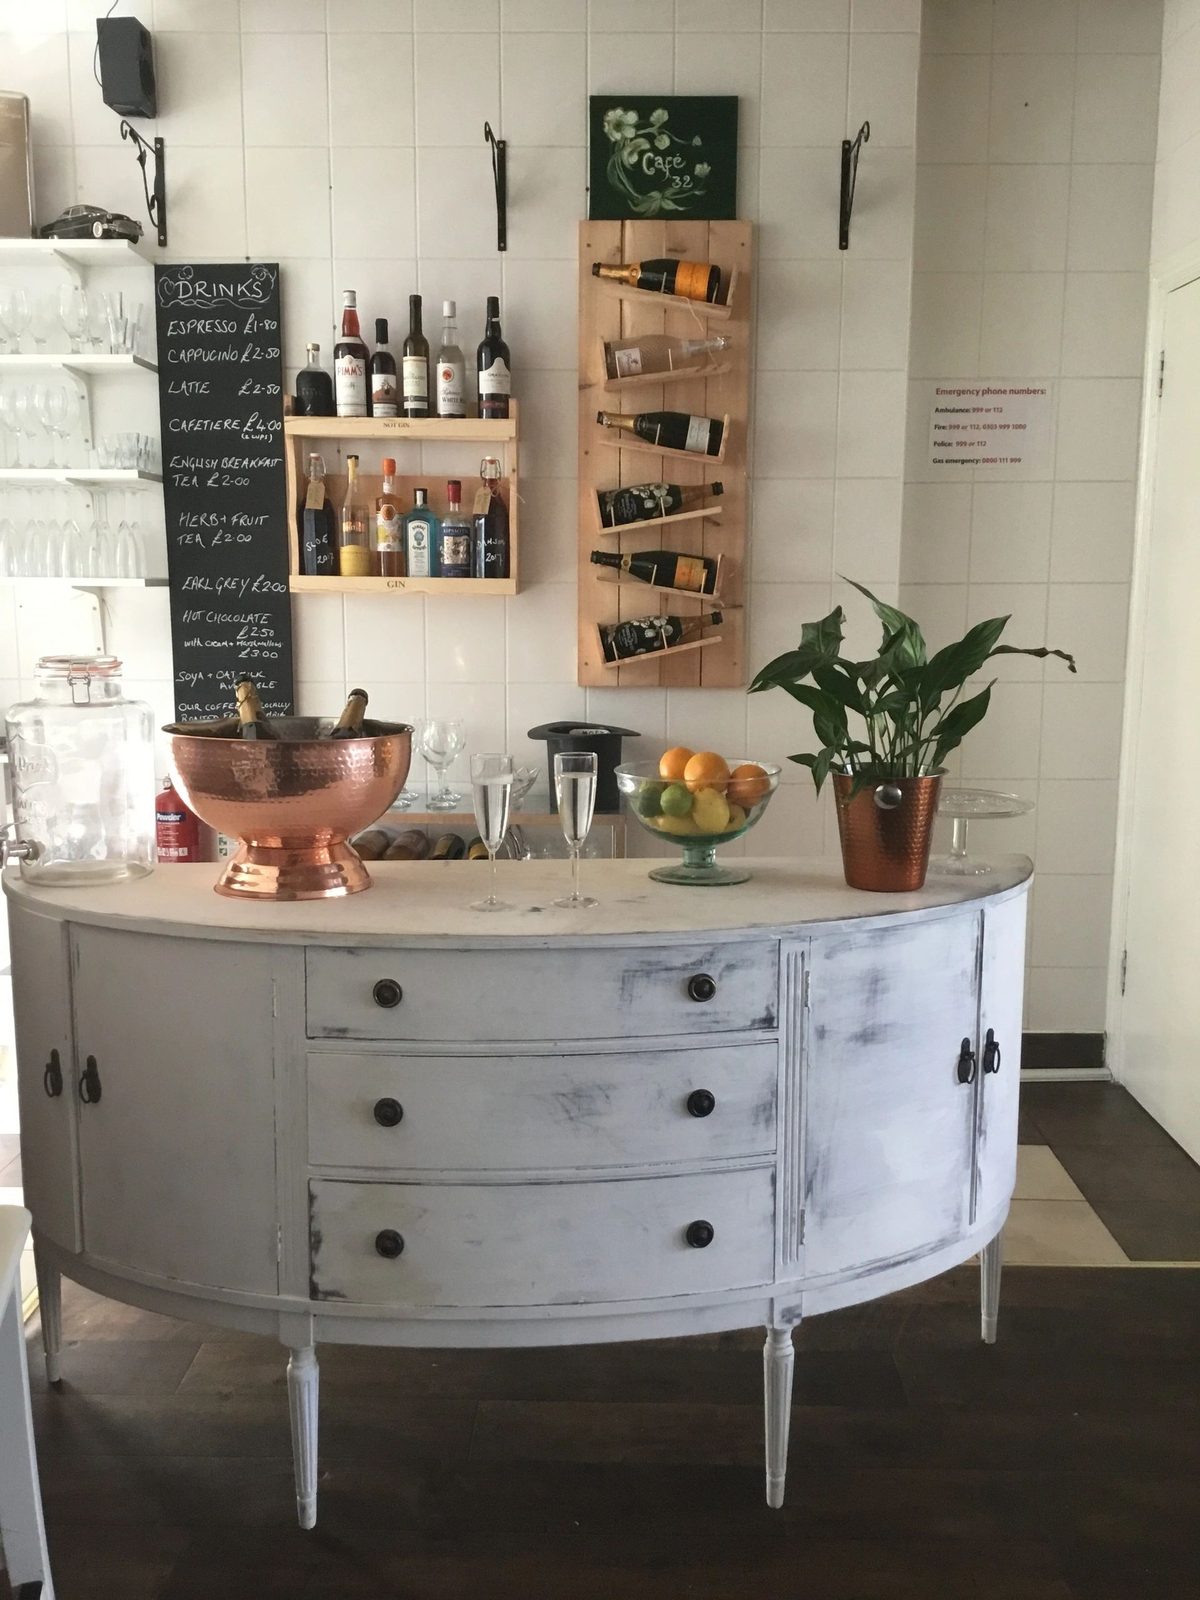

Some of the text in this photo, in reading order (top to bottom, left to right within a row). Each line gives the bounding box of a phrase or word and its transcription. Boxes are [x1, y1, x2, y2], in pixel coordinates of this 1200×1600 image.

[671, 175, 694, 189] 32
[174, 278, 263, 299] DRINKS
[167, 319, 237, 337] ESPRESSO
[168, 344, 238, 363] CAPPUCINO
[168, 380, 210, 396] LATTE
[935, 387, 1047, 397] Emergency phone numbers:
[169, 418, 241, 433] CAFETIERE
[169, 455, 283, 471] ENGLISH BREAKFAST
[172, 473, 199, 488] TEA
[178, 512, 219, 528] HERB
[231, 512, 270, 526] FRUIT
[177, 533, 206, 549] TEA
[181, 575, 214, 591] EARL
[214, 576, 250, 599] GREY
[386, 580, 406, 588] GIN
[182, 609, 273, 624] HOT CHOCOLATE
[175, 670, 204, 688] SOYA
[215, 670, 236, 680] OAT
[178, 702, 202, 712] OUR
